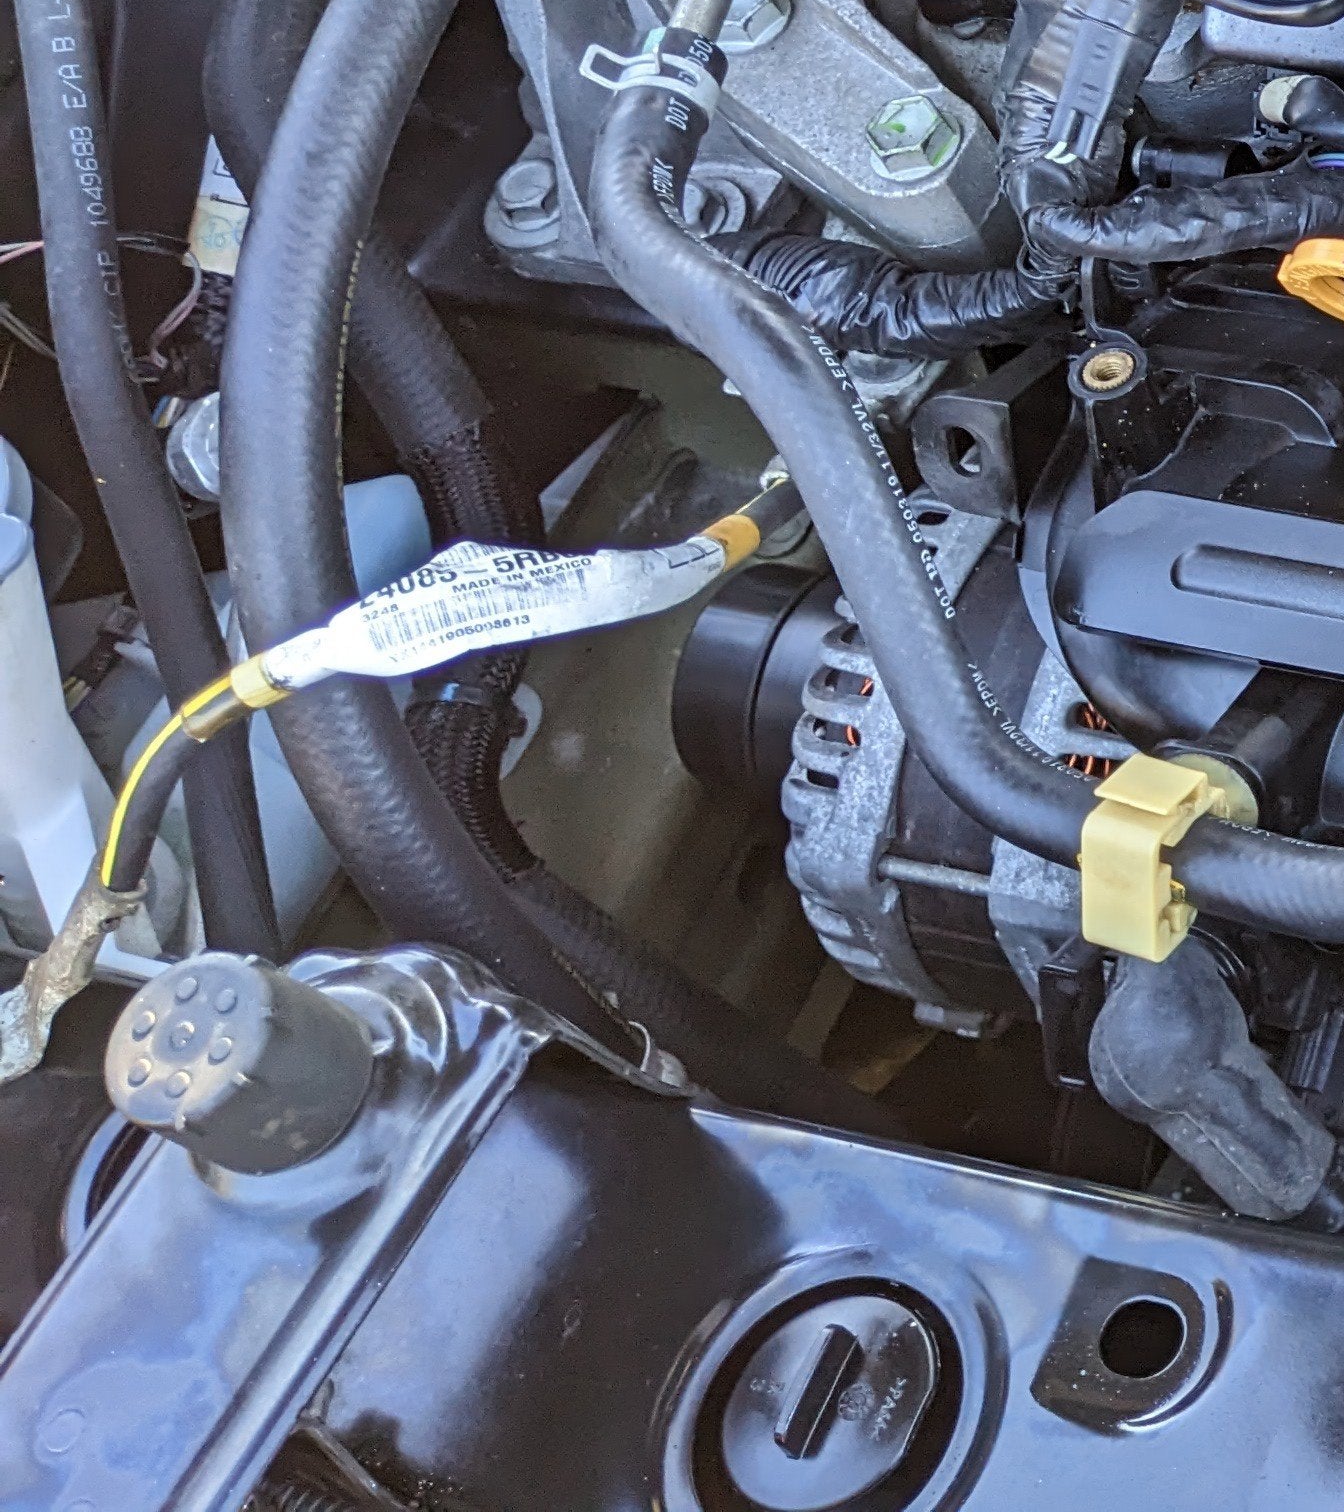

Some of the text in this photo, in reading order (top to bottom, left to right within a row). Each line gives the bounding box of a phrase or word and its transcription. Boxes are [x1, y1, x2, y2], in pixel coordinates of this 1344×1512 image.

[58, 63, 87, 109] E/A
[664, 96, 691, 131] DOT
[452, 556, 592, 594] MADE IN MEXICO
[362, 603, 399, 623] 3248
[933, 584, 955, 620] DOT
